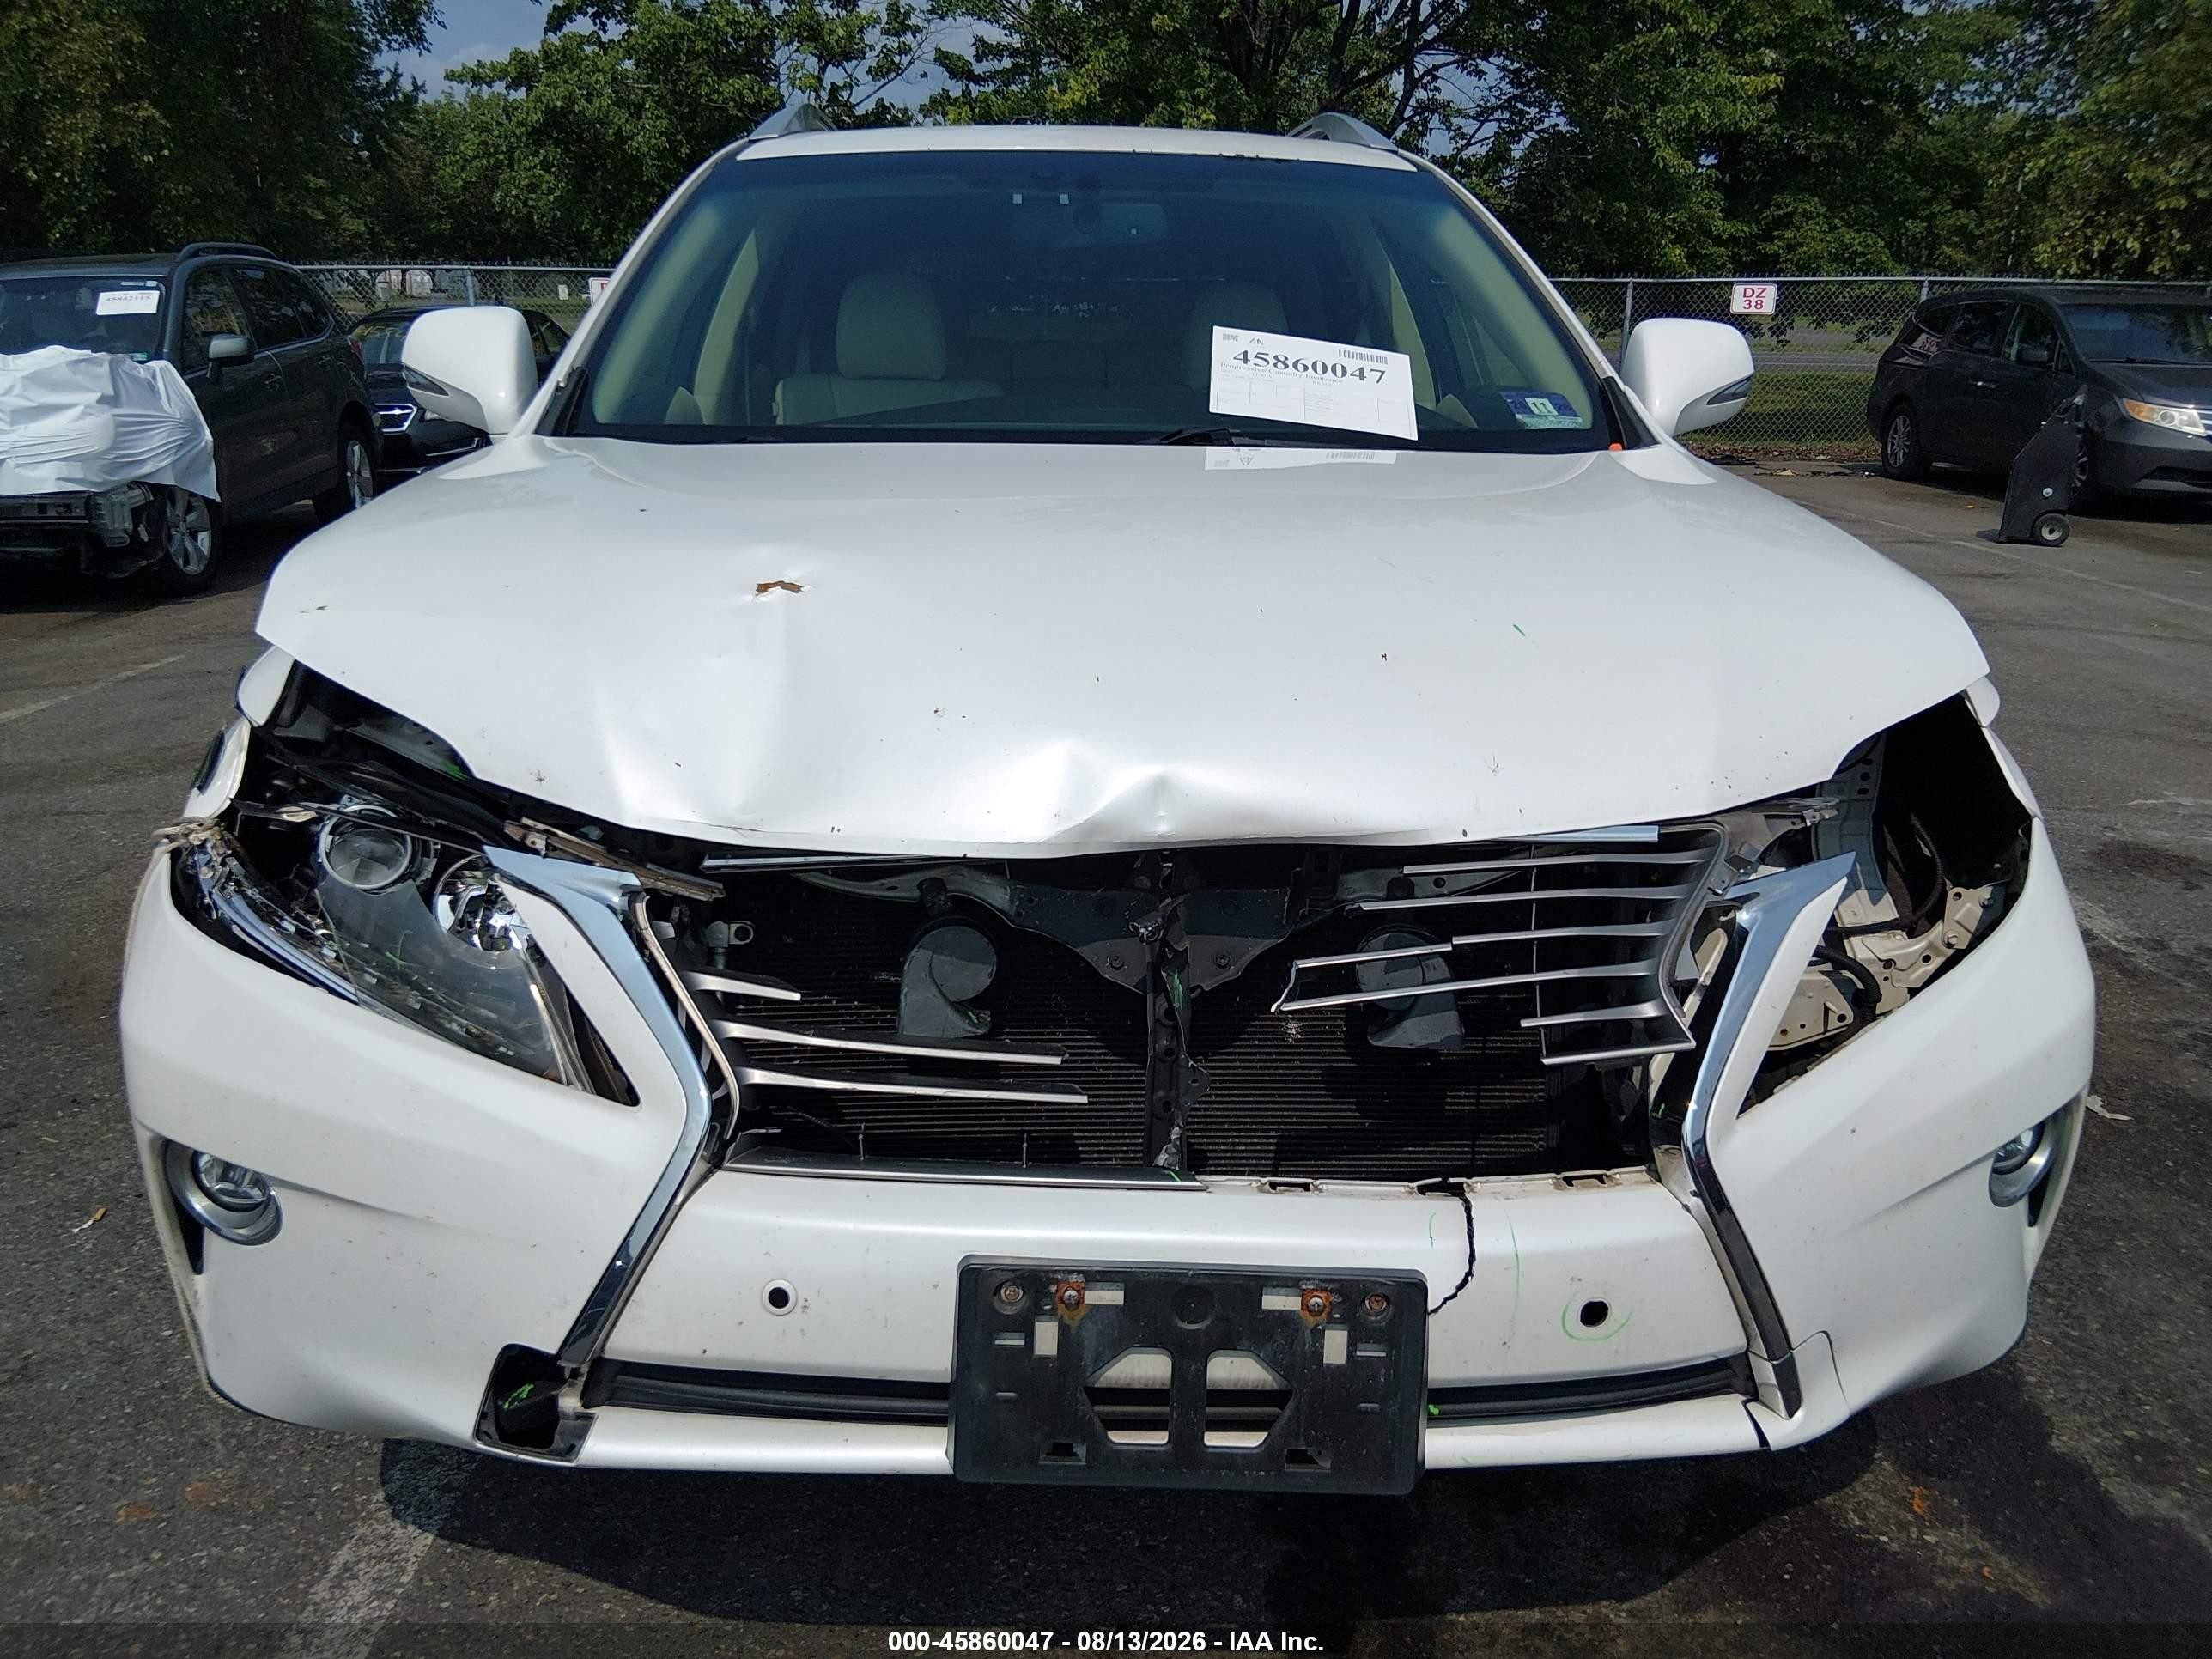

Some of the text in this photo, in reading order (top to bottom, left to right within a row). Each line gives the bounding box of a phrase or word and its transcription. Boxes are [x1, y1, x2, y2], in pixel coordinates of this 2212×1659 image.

[1742, 287, 1767, 298] DZ
[1742, 299, 1764, 310] 38
[1232, 349, 1386, 384] 45860047
